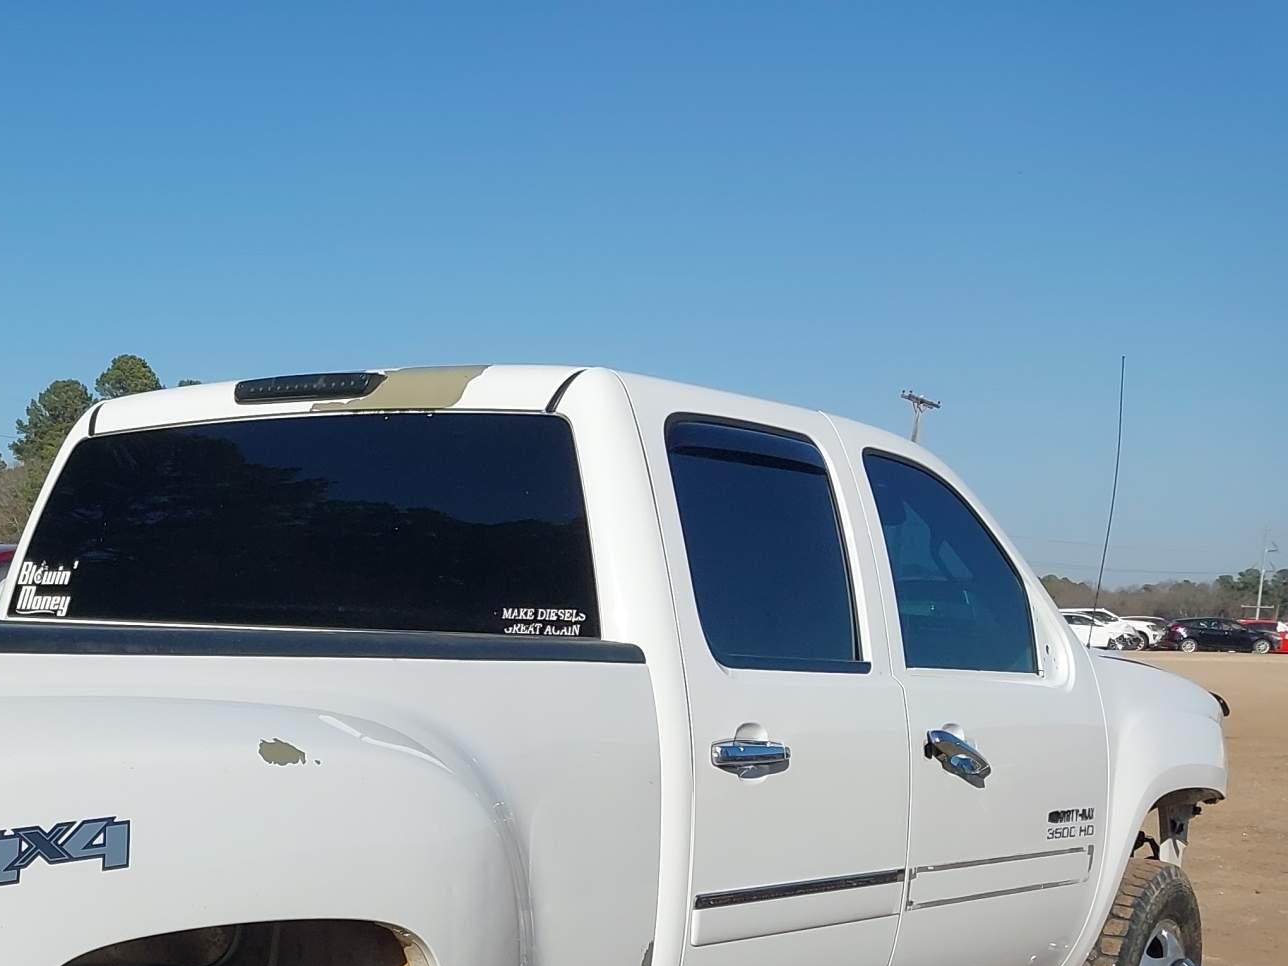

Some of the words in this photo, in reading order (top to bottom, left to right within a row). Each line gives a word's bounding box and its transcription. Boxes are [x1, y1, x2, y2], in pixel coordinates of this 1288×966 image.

[16, 585, 71, 616] Money
[501, 607, 535, 620] MAKE
[1078, 824, 1095, 837] HD
